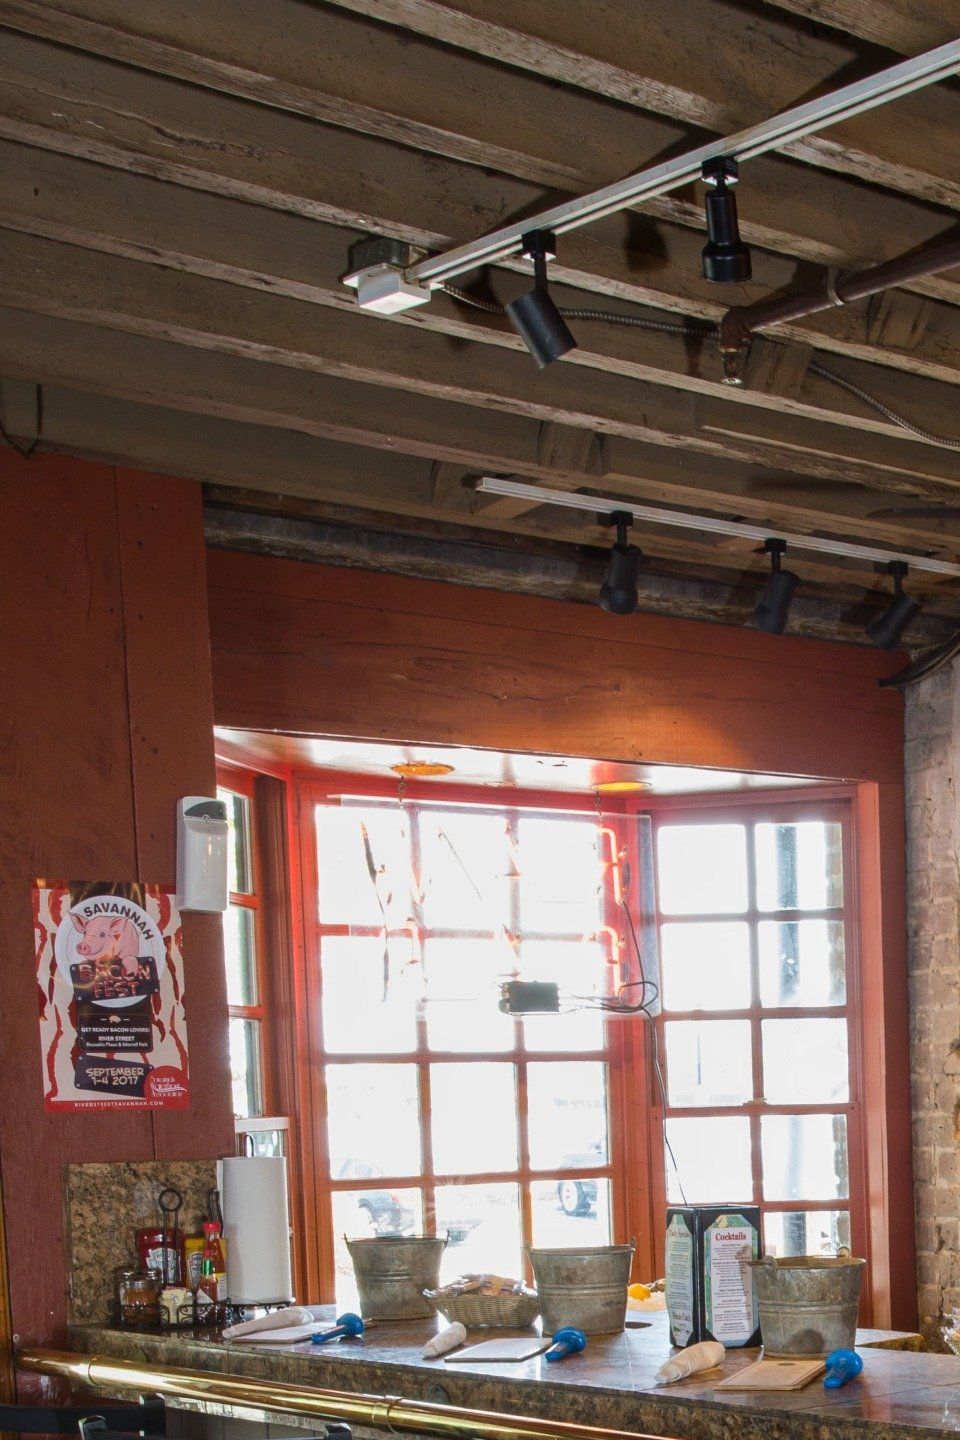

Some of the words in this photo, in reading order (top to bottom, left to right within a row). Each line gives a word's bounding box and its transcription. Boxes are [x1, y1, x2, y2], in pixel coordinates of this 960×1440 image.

[84, 902, 154, 941] SAVANNAH
[93, 981, 139, 998] FEST
[85, 1067, 145, 1077] SEPTEMBER
[91, 1076, 109, 1085] 1-4
[112, 1076, 139, 1085] 2017
[716, 1233, 747, 1241] Cocktails
